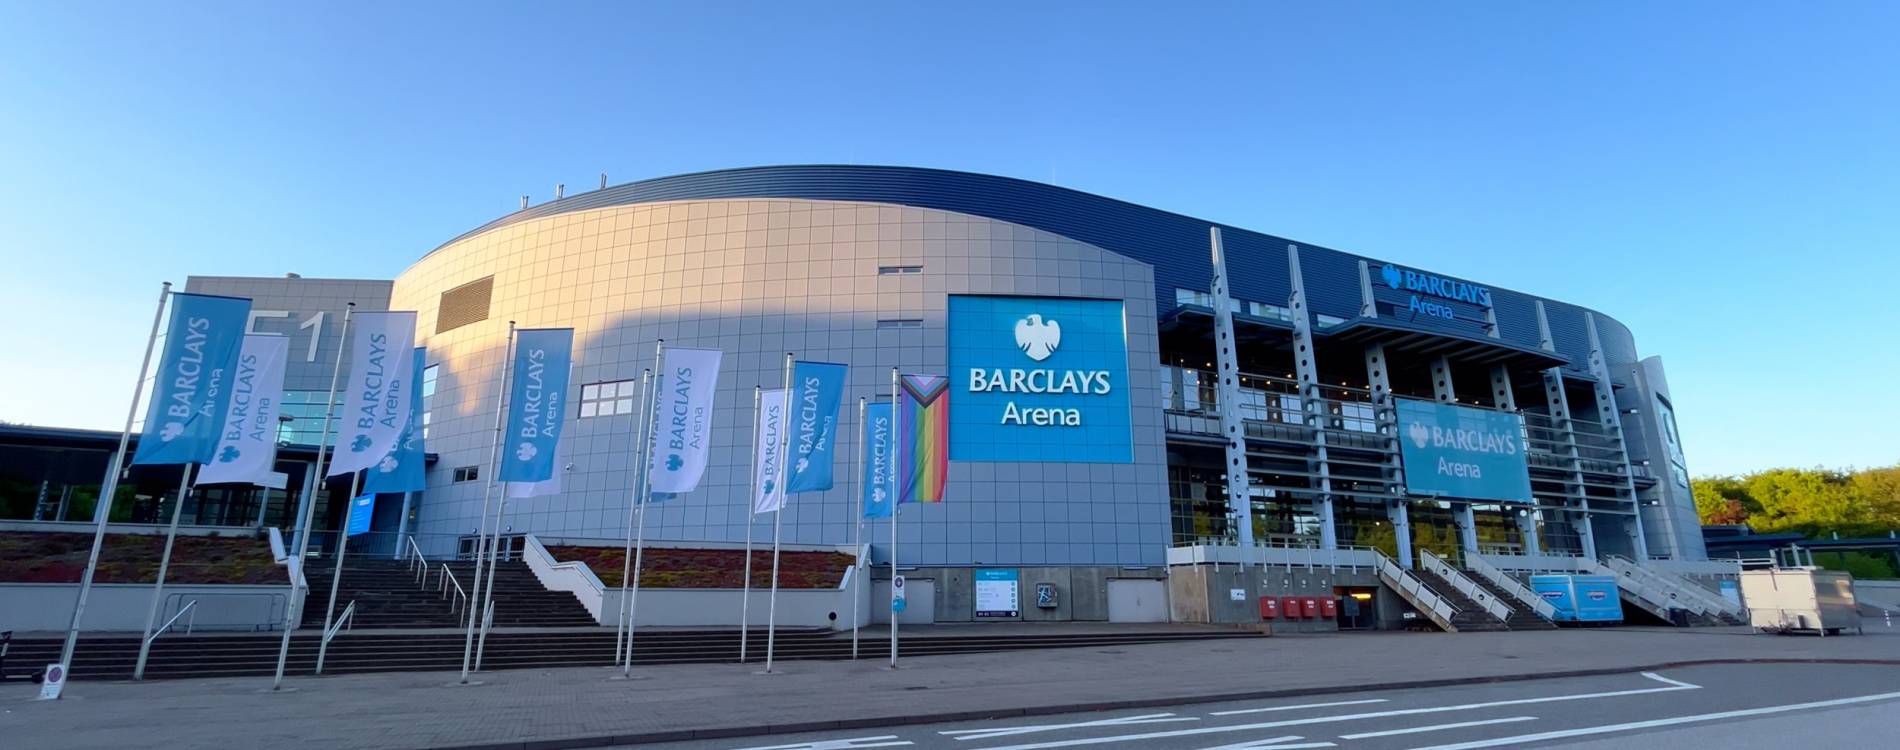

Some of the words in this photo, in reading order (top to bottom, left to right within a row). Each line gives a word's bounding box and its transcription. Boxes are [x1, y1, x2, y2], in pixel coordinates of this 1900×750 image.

[1405, 270, 1489, 306] BARCLAYS
[1410, 295, 1454, 320] Arena
[168, 317, 210, 418] BARCLAYS
[358, 333, 387, 429] BARCLAYS
[969, 368, 1111, 394] BARCLAYS
[226, 353, 257, 441] BARCLAYS
[380, 379, 401, 429] Arena
[521, 348, 545, 438] BARCLAYS
[541, 391, 558, 437] Arena
[670, 367, 692, 450] BARCLAYS
[799, 377, 819, 454] BARCLAYS
[1001, 401, 1081, 426] Arena
[249, 397, 271, 442] Arena
[689, 407, 704, 450] Arena
[764, 405, 780, 475] BARCLAYS
[1432, 425, 1516, 455] BARCLAYS
[873, 417, 888, 485] BARCLAYS
[1438, 456, 1481, 479] Arena
